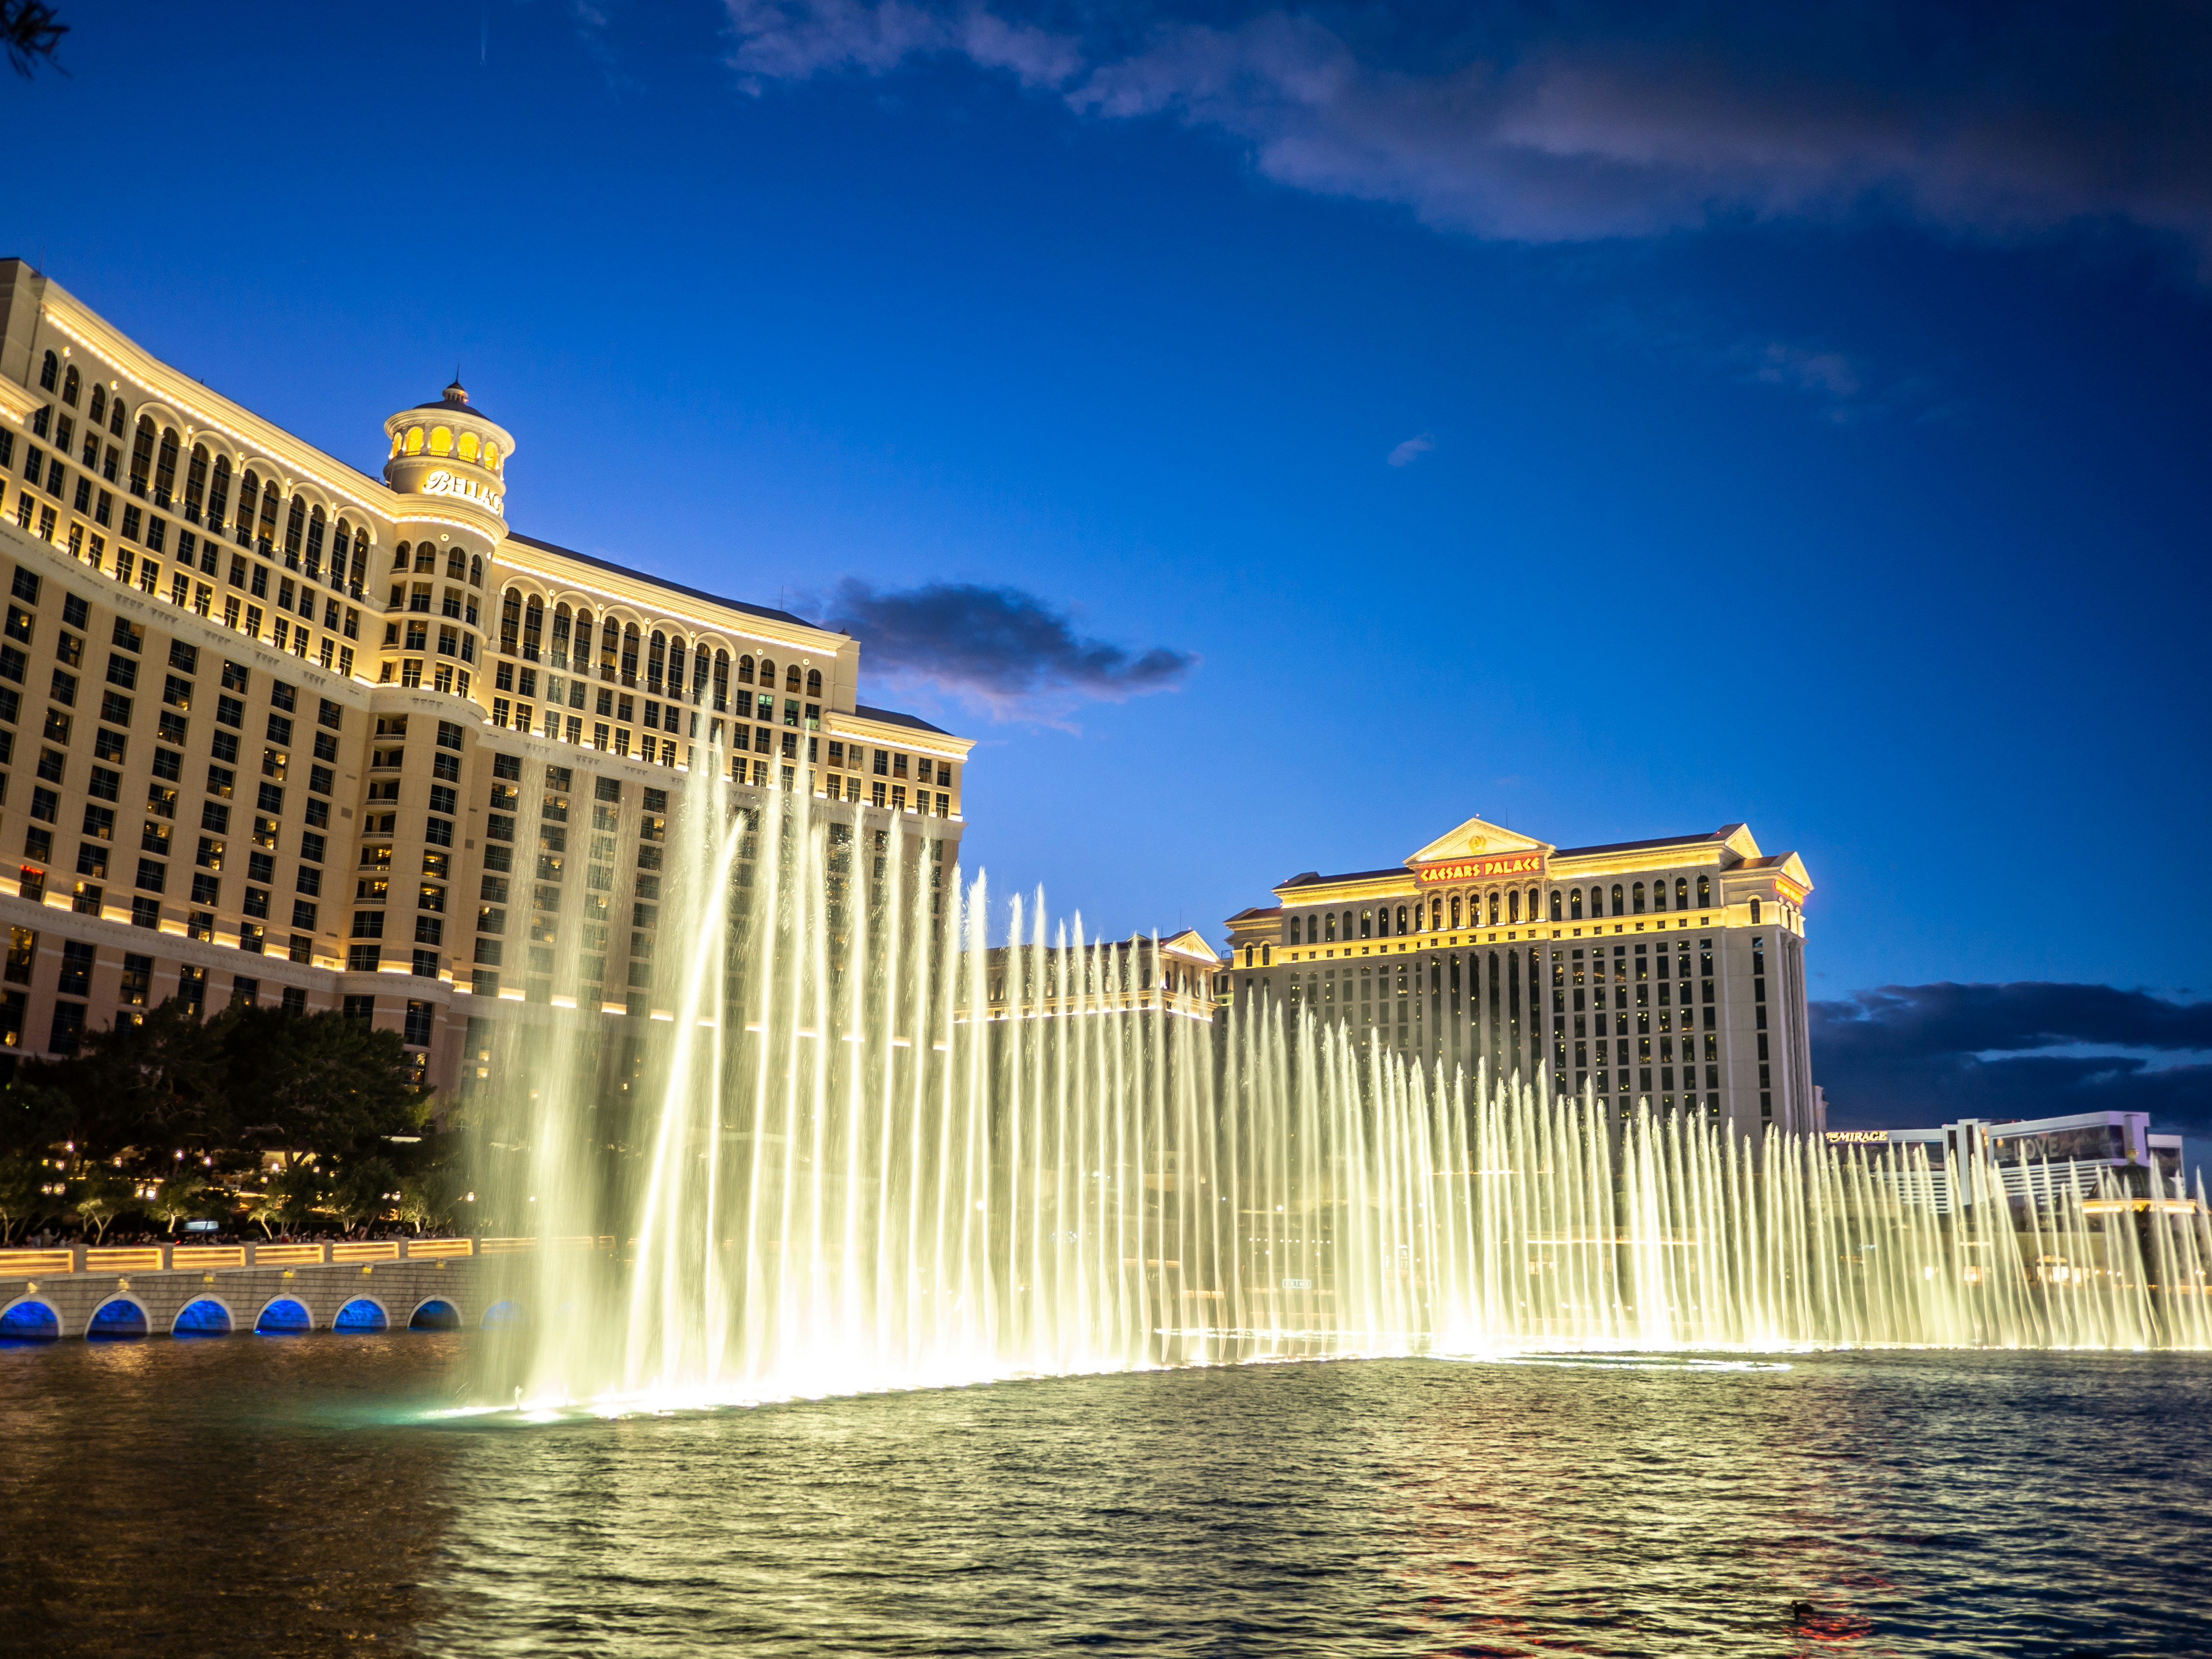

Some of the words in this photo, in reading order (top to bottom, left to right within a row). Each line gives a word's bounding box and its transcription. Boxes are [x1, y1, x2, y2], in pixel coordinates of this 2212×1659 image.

[423, 470, 502, 511] BELLAG
[1420, 864, 1481, 882] CAESARS
[1484, 857, 1540, 875] PALACE
[1830, 1131, 1887, 1143] MIRAGE
[2014, 1136, 2059, 1160] LOVE
